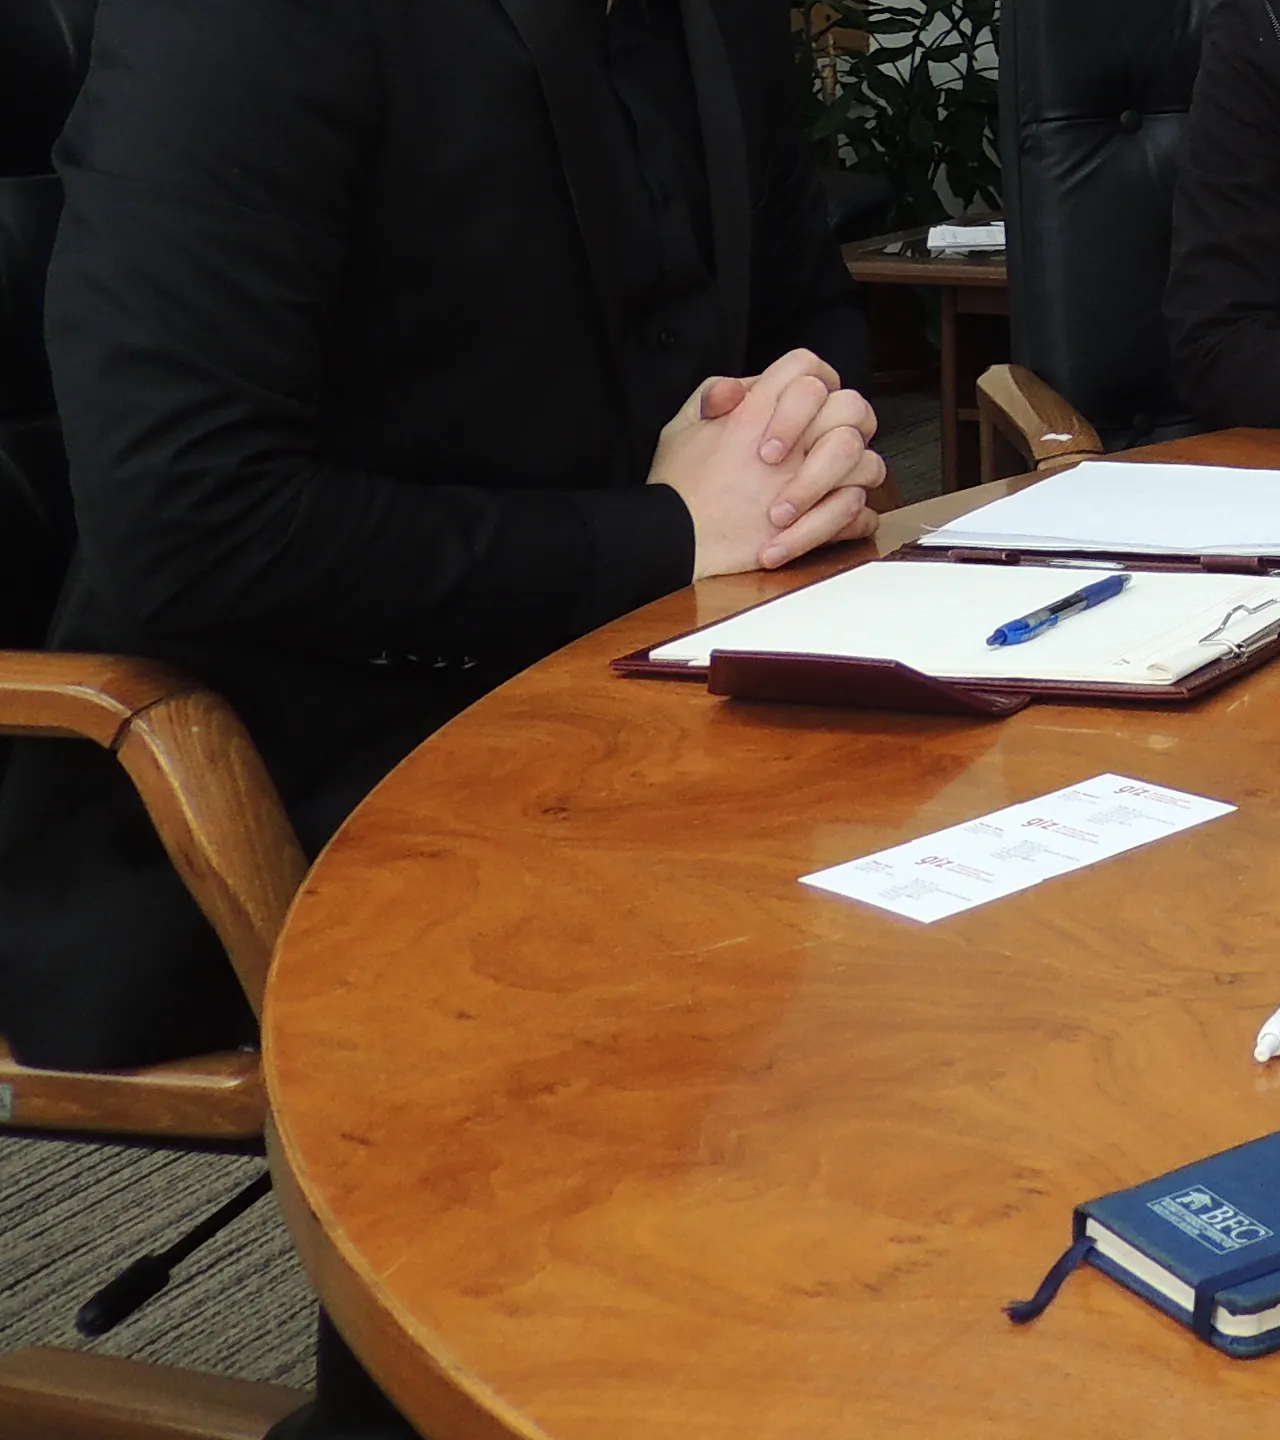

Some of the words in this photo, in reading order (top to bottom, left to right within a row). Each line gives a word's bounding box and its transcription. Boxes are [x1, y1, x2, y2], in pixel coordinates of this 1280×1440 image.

[1113, 785, 1150, 797] giz
[1020, 817, 1059, 830] giz
[914, 855, 954, 868] giz
[1200, 1205, 1266, 1244] BFC
